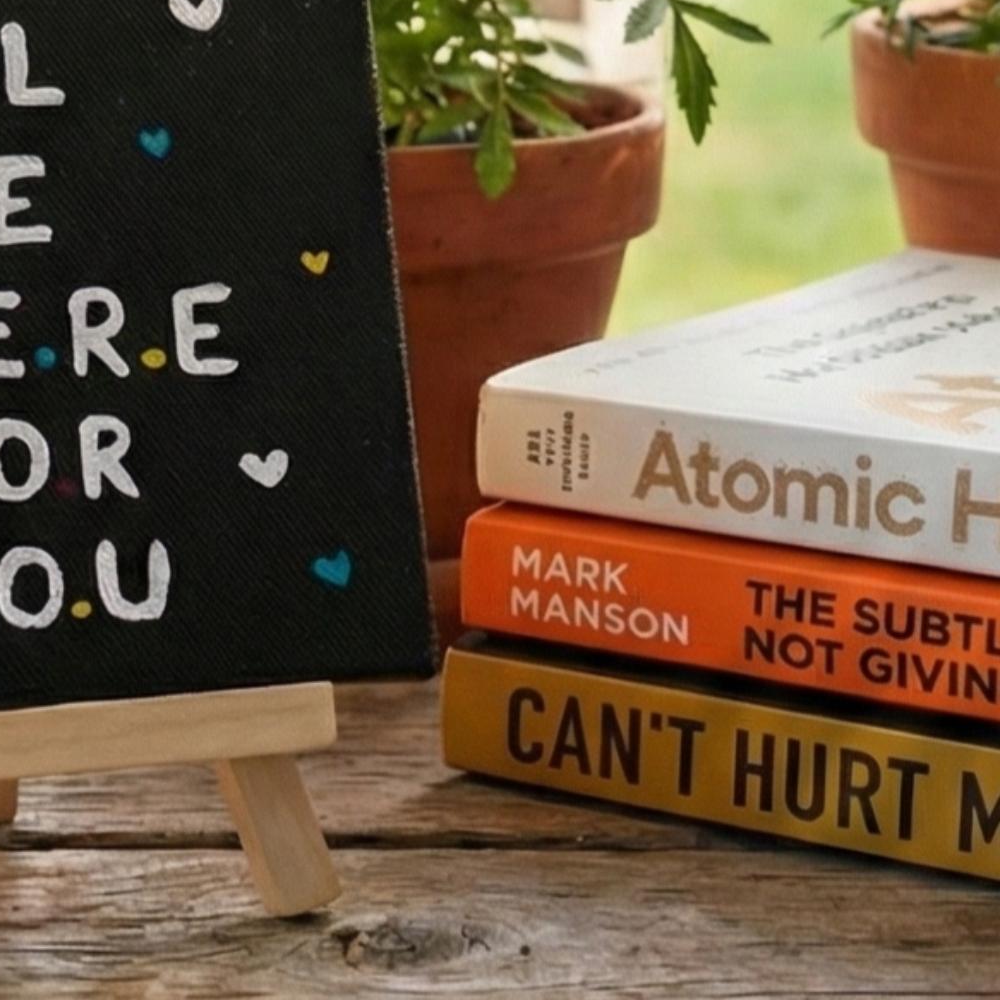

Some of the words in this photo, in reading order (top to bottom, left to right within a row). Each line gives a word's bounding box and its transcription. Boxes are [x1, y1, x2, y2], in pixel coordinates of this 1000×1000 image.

[631, 429, 926, 537] Atomic
[511, 545, 628, 596] MARK
[745, 579, 838, 627] THE
[510, 586, 690, 647] MANSON
[744, 625, 844, 675] NOT
[859, 647, 1000, 706] GIVIN
[507, 687, 706, 797] CAN'T
[733, 728, 930, 842] HURT
